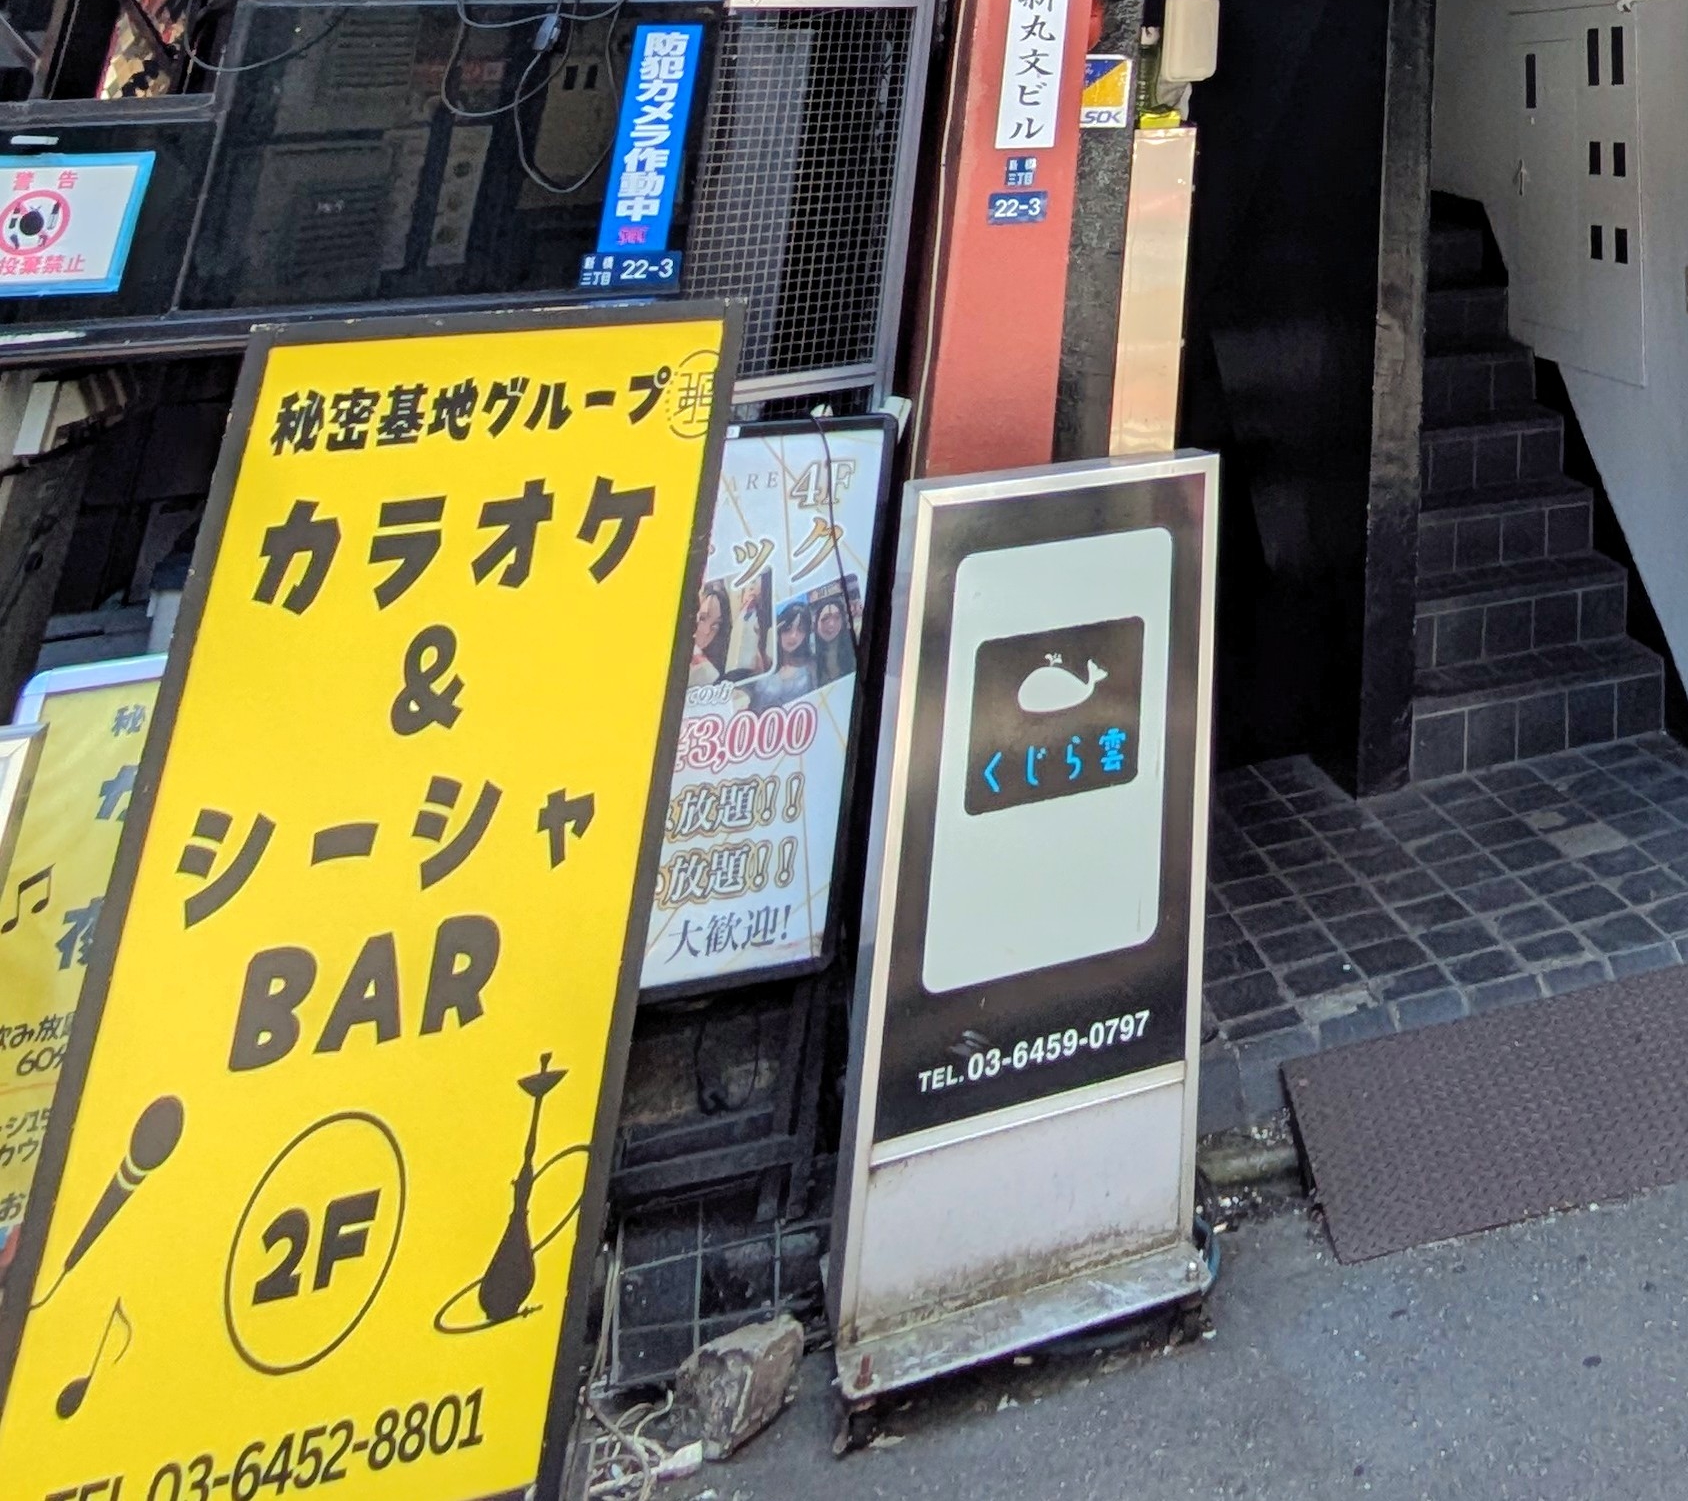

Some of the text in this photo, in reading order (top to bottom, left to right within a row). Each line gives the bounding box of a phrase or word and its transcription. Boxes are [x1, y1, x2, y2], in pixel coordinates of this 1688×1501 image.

[615, 32, 690, 222] 防犯カメラ作動中
[995, 197, 1041, 218] 22-3
[620, 257, 675, 280] 22-3
[270, 365, 673, 456] 秘密基地グループ
[789, 458, 857, 508] 4F
[253, 476, 656, 616] カラオケ
[390, 624, 466, 737] &
[667, 773, 804, 837] 放題!!
[983, 726, 1128, 794] くじら雲
[175, 776, 596, 929] シーシャ
[664, 904, 791, 964] 大歓迎!
[228, 915, 501, 1072] BAR
[918, 1009, 1151, 1093] TEL. 03-6459-0797
[252, 1188, 383, 1306] 2F
[148, 1386, 485, 1501] 03-6452-8801
